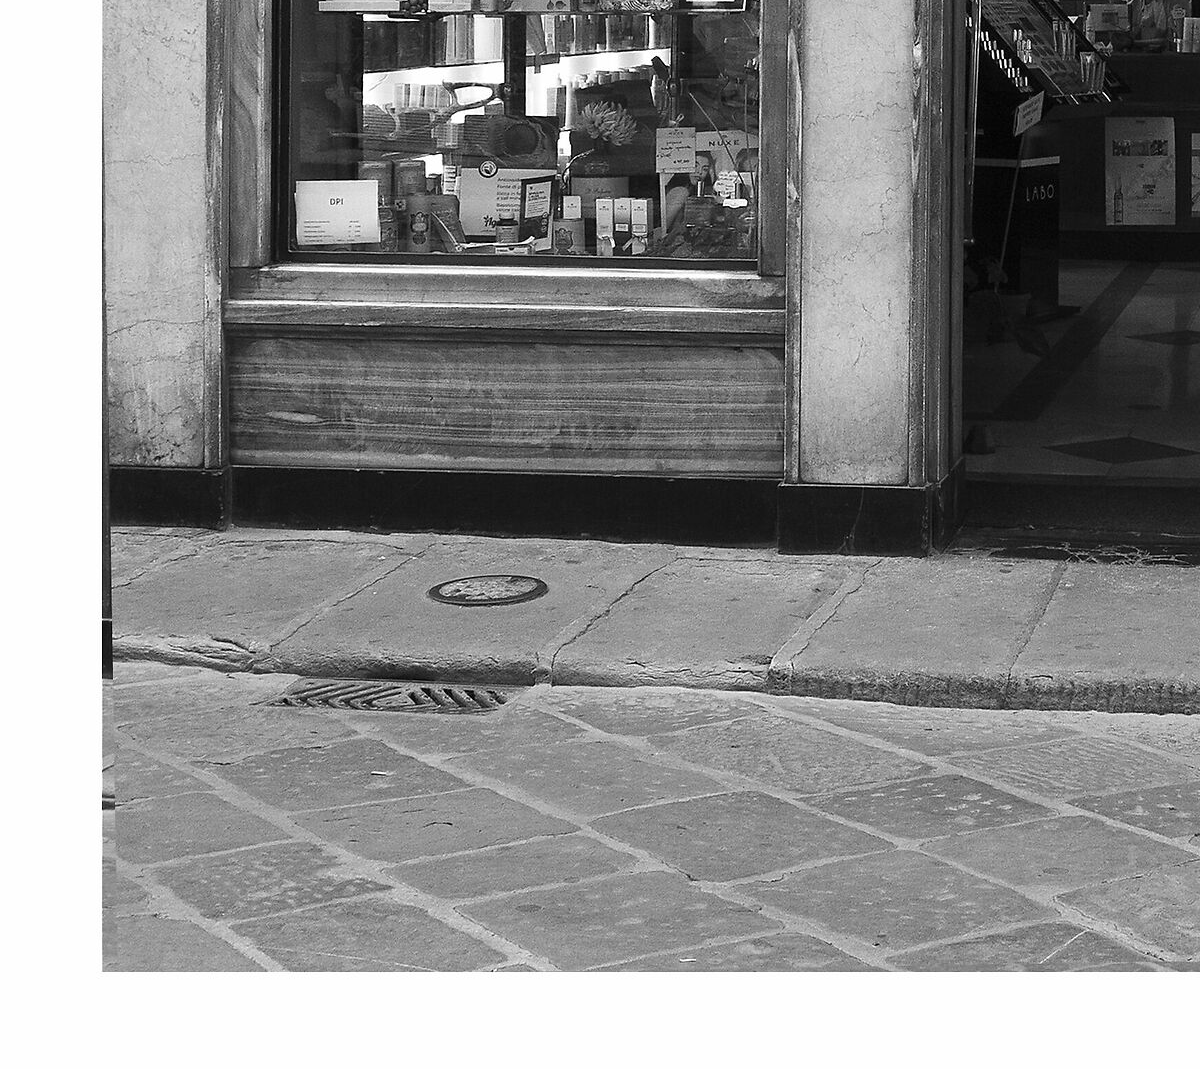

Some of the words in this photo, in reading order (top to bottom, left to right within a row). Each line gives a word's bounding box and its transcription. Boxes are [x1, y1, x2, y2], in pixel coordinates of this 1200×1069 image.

[708, 139, 740, 147] NUXE
[1025, 185, 1055, 202] LABO
[329, 198, 344, 206] DPI
